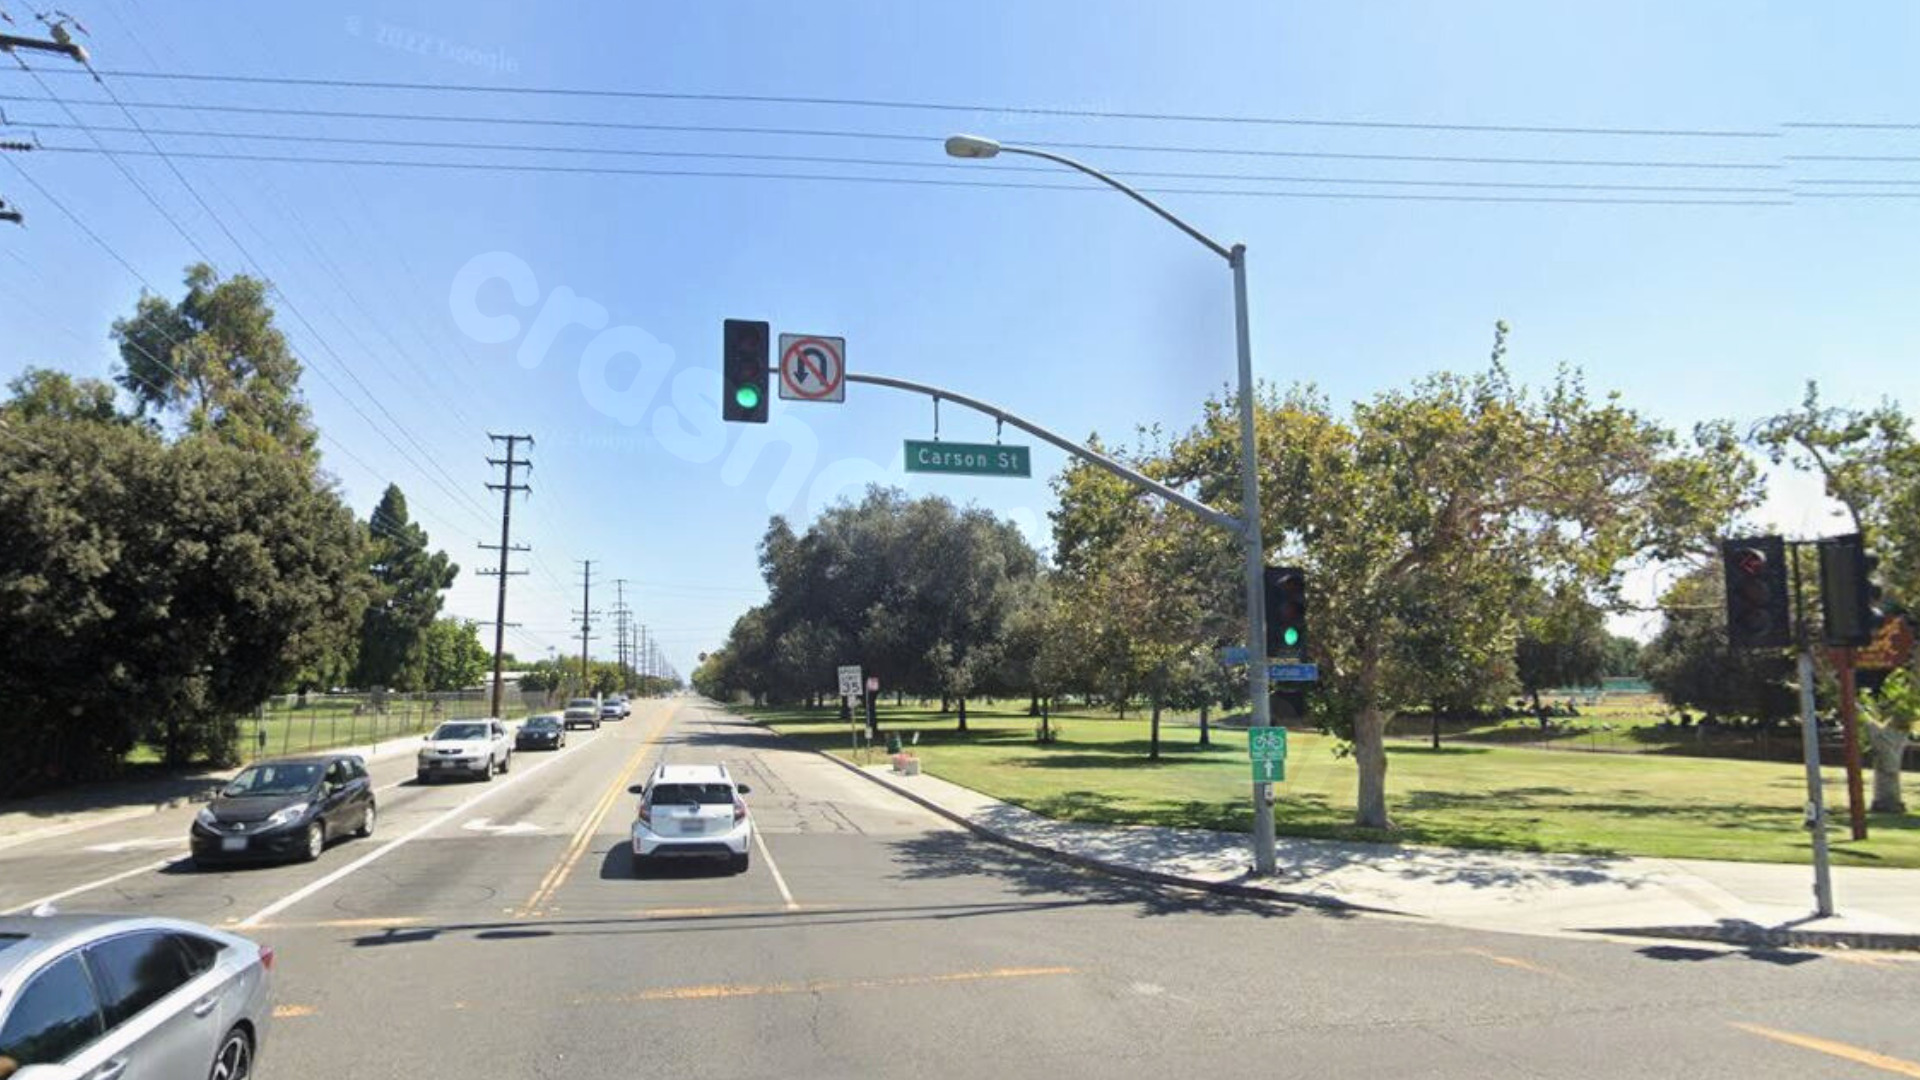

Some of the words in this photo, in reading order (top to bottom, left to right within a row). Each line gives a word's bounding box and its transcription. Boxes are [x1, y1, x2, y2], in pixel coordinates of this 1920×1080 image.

[918, 448, 987, 468] Carson
[997, 452, 1018, 470] St
[842, 682, 860, 693] 35
